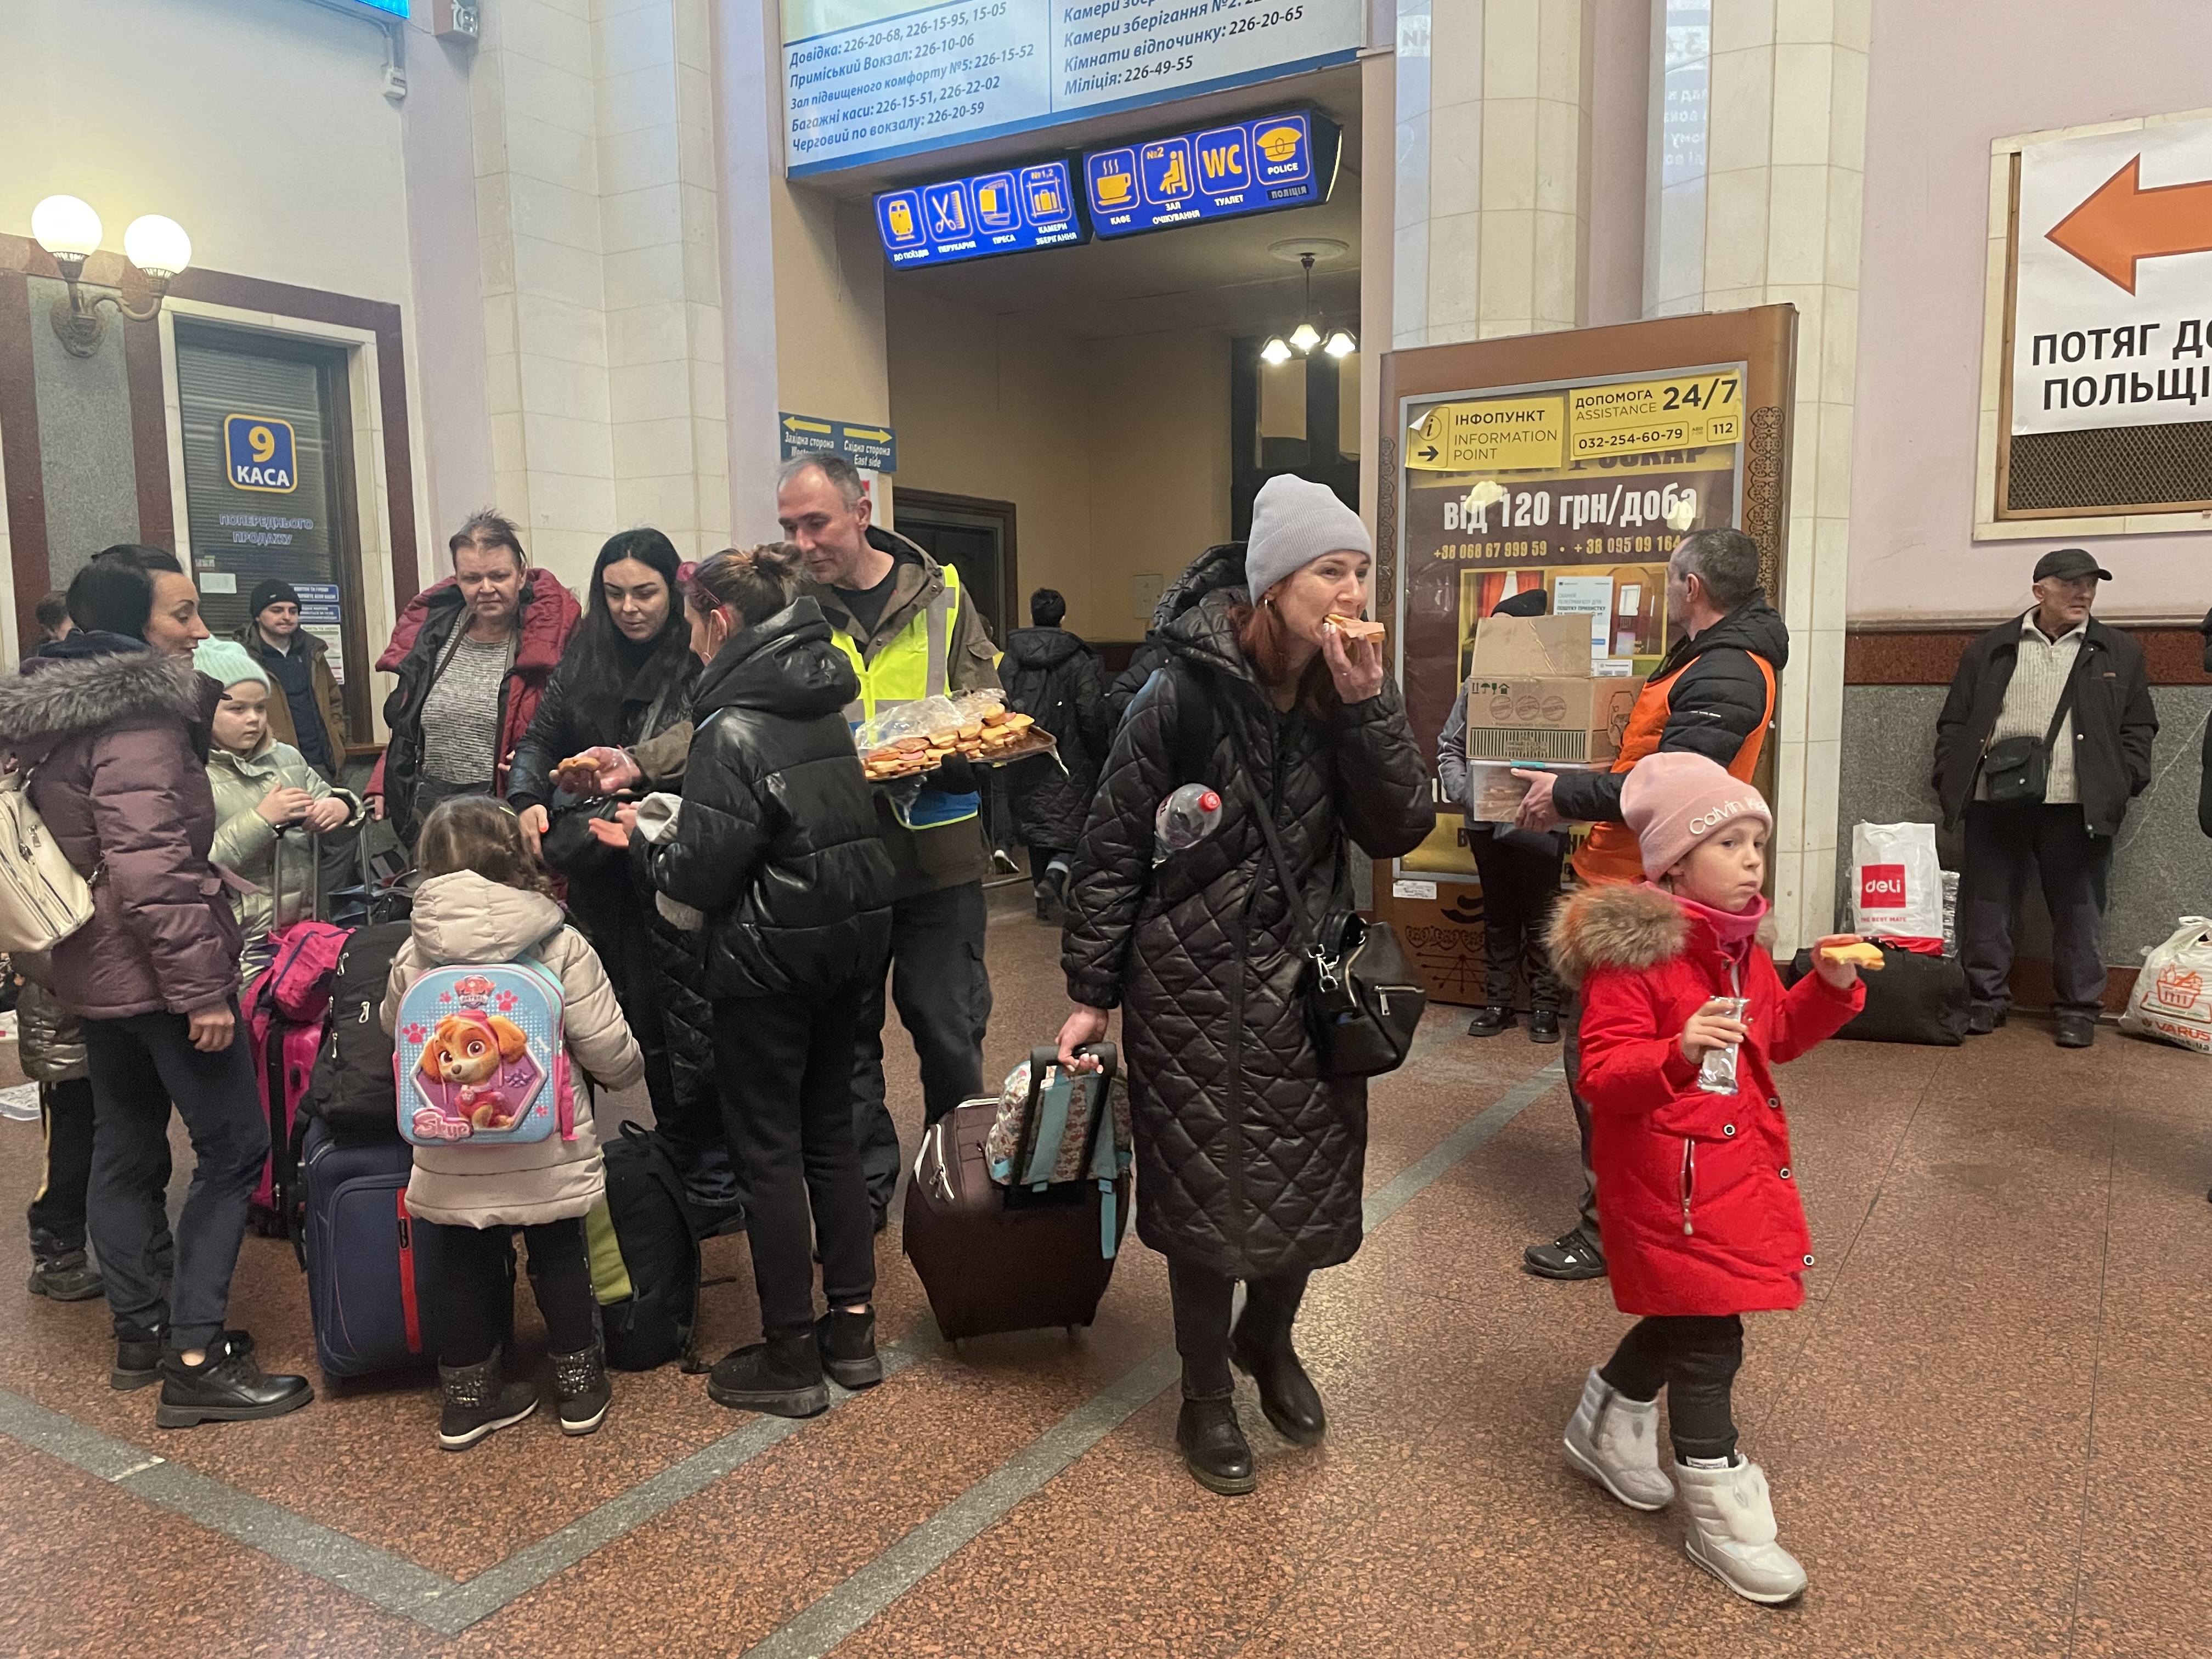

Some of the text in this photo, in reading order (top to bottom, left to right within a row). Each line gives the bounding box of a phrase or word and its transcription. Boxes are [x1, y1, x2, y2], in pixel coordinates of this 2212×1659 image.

[1064, 3, 1120, 24] Камери
[1064, 26, 1119, 47] Камери
[1122, 3, 1207, 34] зберігання
[789, 2, 1007, 69] Довідка: 226-20-68, 226-15-95, 15-05
[1064, 5, 1304, 72] Кімнати відпочинку: 226-20-65
[790, 33, 974, 89] Приміський Вокзал: 226-10-06
[791, 44, 1034, 110] Зал підвищеного комфорту №5: 226-15-52
[1064, 55, 1193, 95] Міліція: 226-49-55
[792, 76, 1000, 133] Багажні каси: 226-15-51, 226-22-02
[793, 101, 984, 153] Черговий по вокзалу: 226-20-59
[1203, 144, 1242, 178] WC
[1267, 162, 1299, 176] POLICE
[1215, 194, 1244, 207] ТУАЛЕТ
[1272, 185, 1307, 200] ПОЛІЦІЯ
[1166, 201, 1181, 212] ЗАЛ
[1039, 223, 1068, 234] КАМЕРИ
[1110, 215, 1131, 225] КАФЕ
[993, 234, 1016, 245] ПРЕСА
[2032, 319, 2212, 366] ПОТЯГ Д
[1662, 379, 1738, 411] 24/7
[2044, 365, 2210, 410] ПОЛЬЩІ
[1575, 389, 1653, 409] ДОПОМОГА
[1455, 410, 1545, 426] ІНФОПУНКТ
[1576, 402, 1657, 421] ASSISTANCE
[1454, 430, 1558, 445] INFORMATION
[1712, 422, 1733, 435] 112
[249, 426, 275, 462] 9
[810, 438, 834, 449] сторона
[1578, 428, 1683, 449] 032-254-60-79
[866, 445, 890, 456] сторона
[1454, 448, 1498, 461] POINT
[854, 454, 881, 467] East side
[237, 465, 290, 487] КАСА
[1499, 491, 1550, 528] 120
[1559, 483, 1697, 532] грн/доба
[219, 514, 313, 530] ПОПЕРЕДНЬОГО
[233, 531, 292, 546] ПРОДАЖУ
[1635, 536, 1651, 552] 09
[1504, 541, 1528, 557] 999
[1531, 540, 1547, 556] 59
[1690, 800, 1745, 834] Calvin
[1866, 880, 1900, 893] deli
[2155, 1020, 2210, 1041] VARUS
